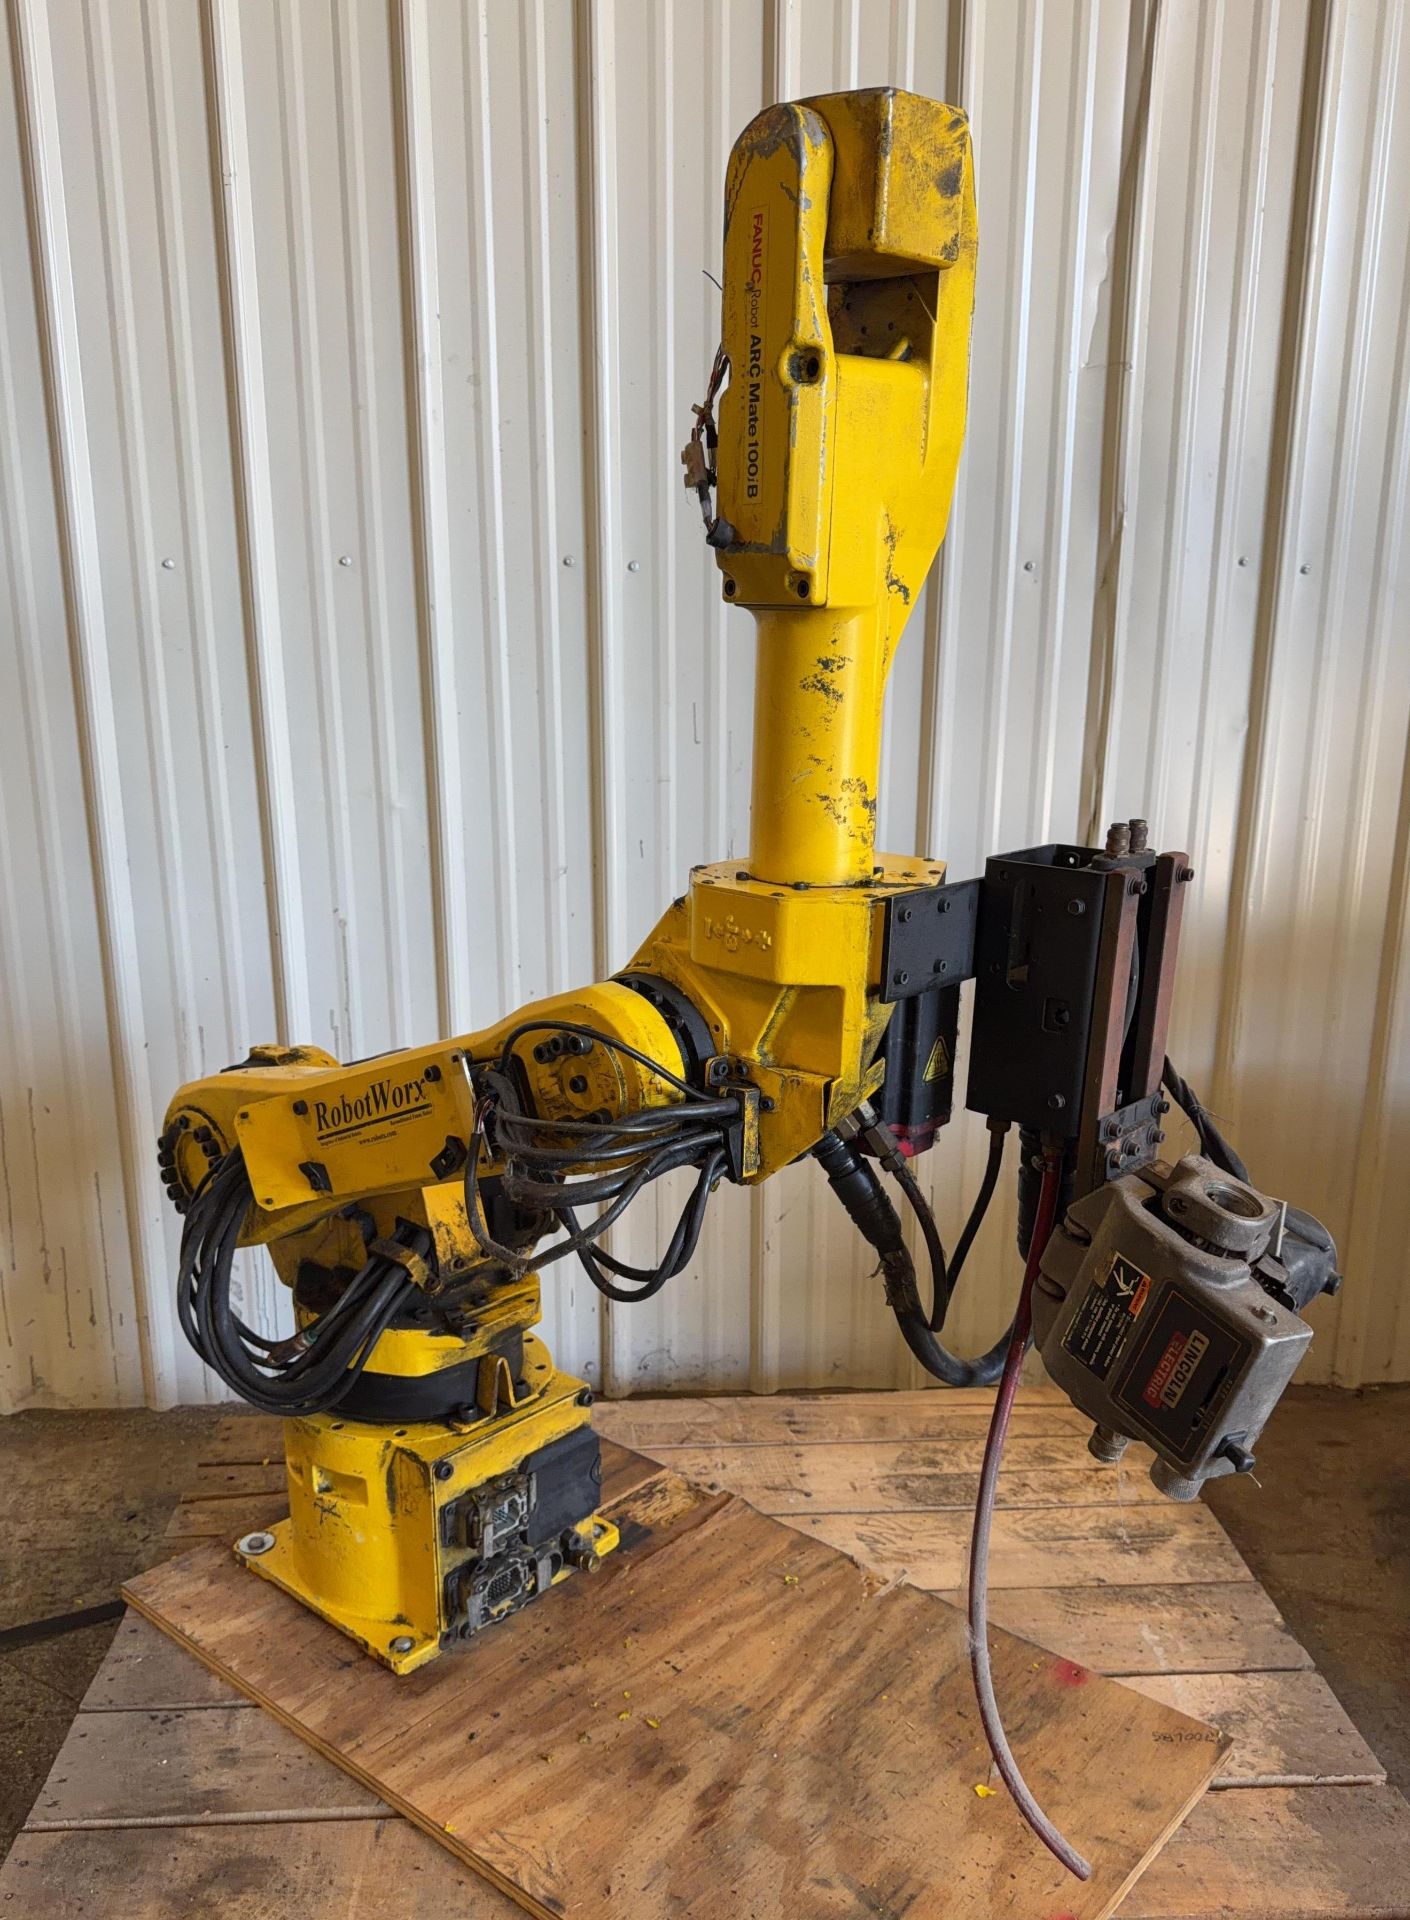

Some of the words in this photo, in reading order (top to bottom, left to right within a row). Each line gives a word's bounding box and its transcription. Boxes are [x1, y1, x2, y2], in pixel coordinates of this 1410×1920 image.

[752, 213, 763, 284] FANUC
[750, 289, 761, 328] Robot
[749, 334, 762, 378] ARC
[748, 382, 760, 437] Mate
[747, 440, 759, 498] 100iB
[314, 1077, 427, 1131] RobotWorx
[1147, 1340, 1182, 1398] ELECTRIC
[1164, 1335, 1206, 1402] LINCOLN
